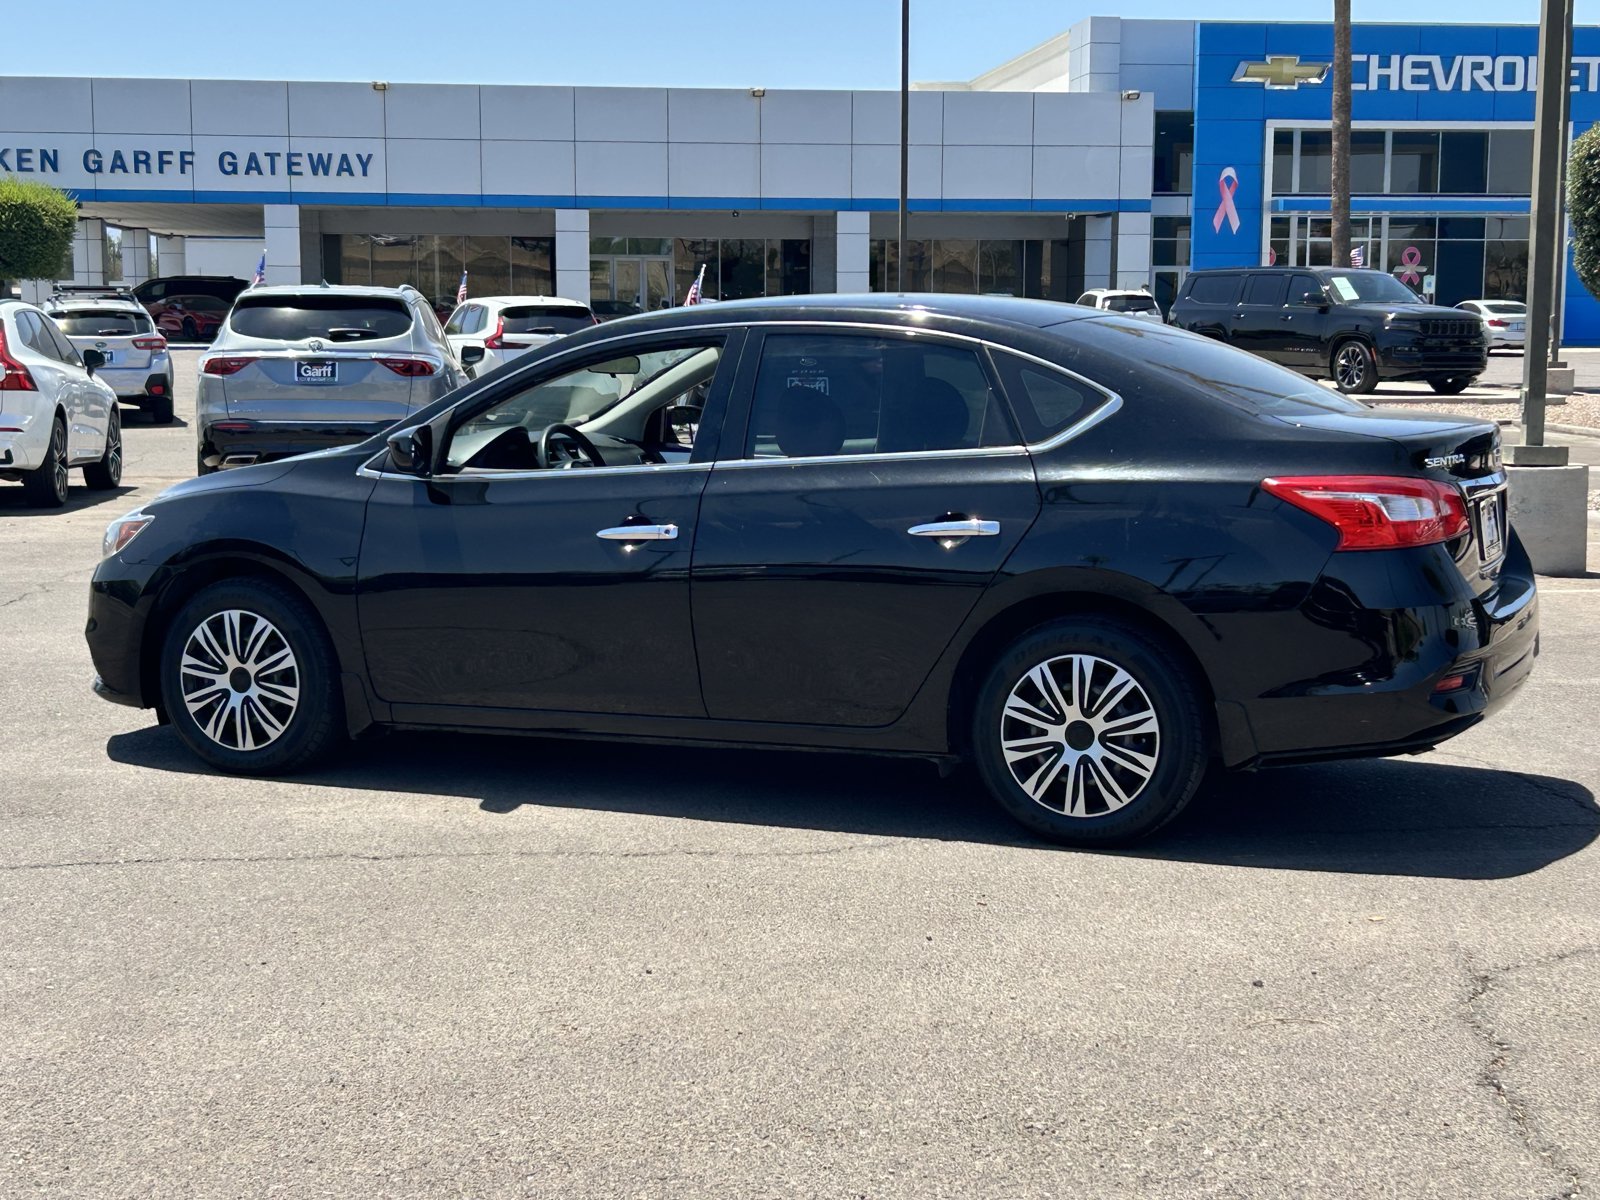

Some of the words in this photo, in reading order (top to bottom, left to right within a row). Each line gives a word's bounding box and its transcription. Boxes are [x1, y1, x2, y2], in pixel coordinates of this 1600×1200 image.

[1351, 54, 1600, 92] CHEVROT
[0, 148, 59, 173] KEN
[82, 149, 196, 174] GARFF
[218, 151, 374, 177] GATEWAY
[300, 365, 332, 377] Garff
[1424, 453, 1466, 468] SENTRA
